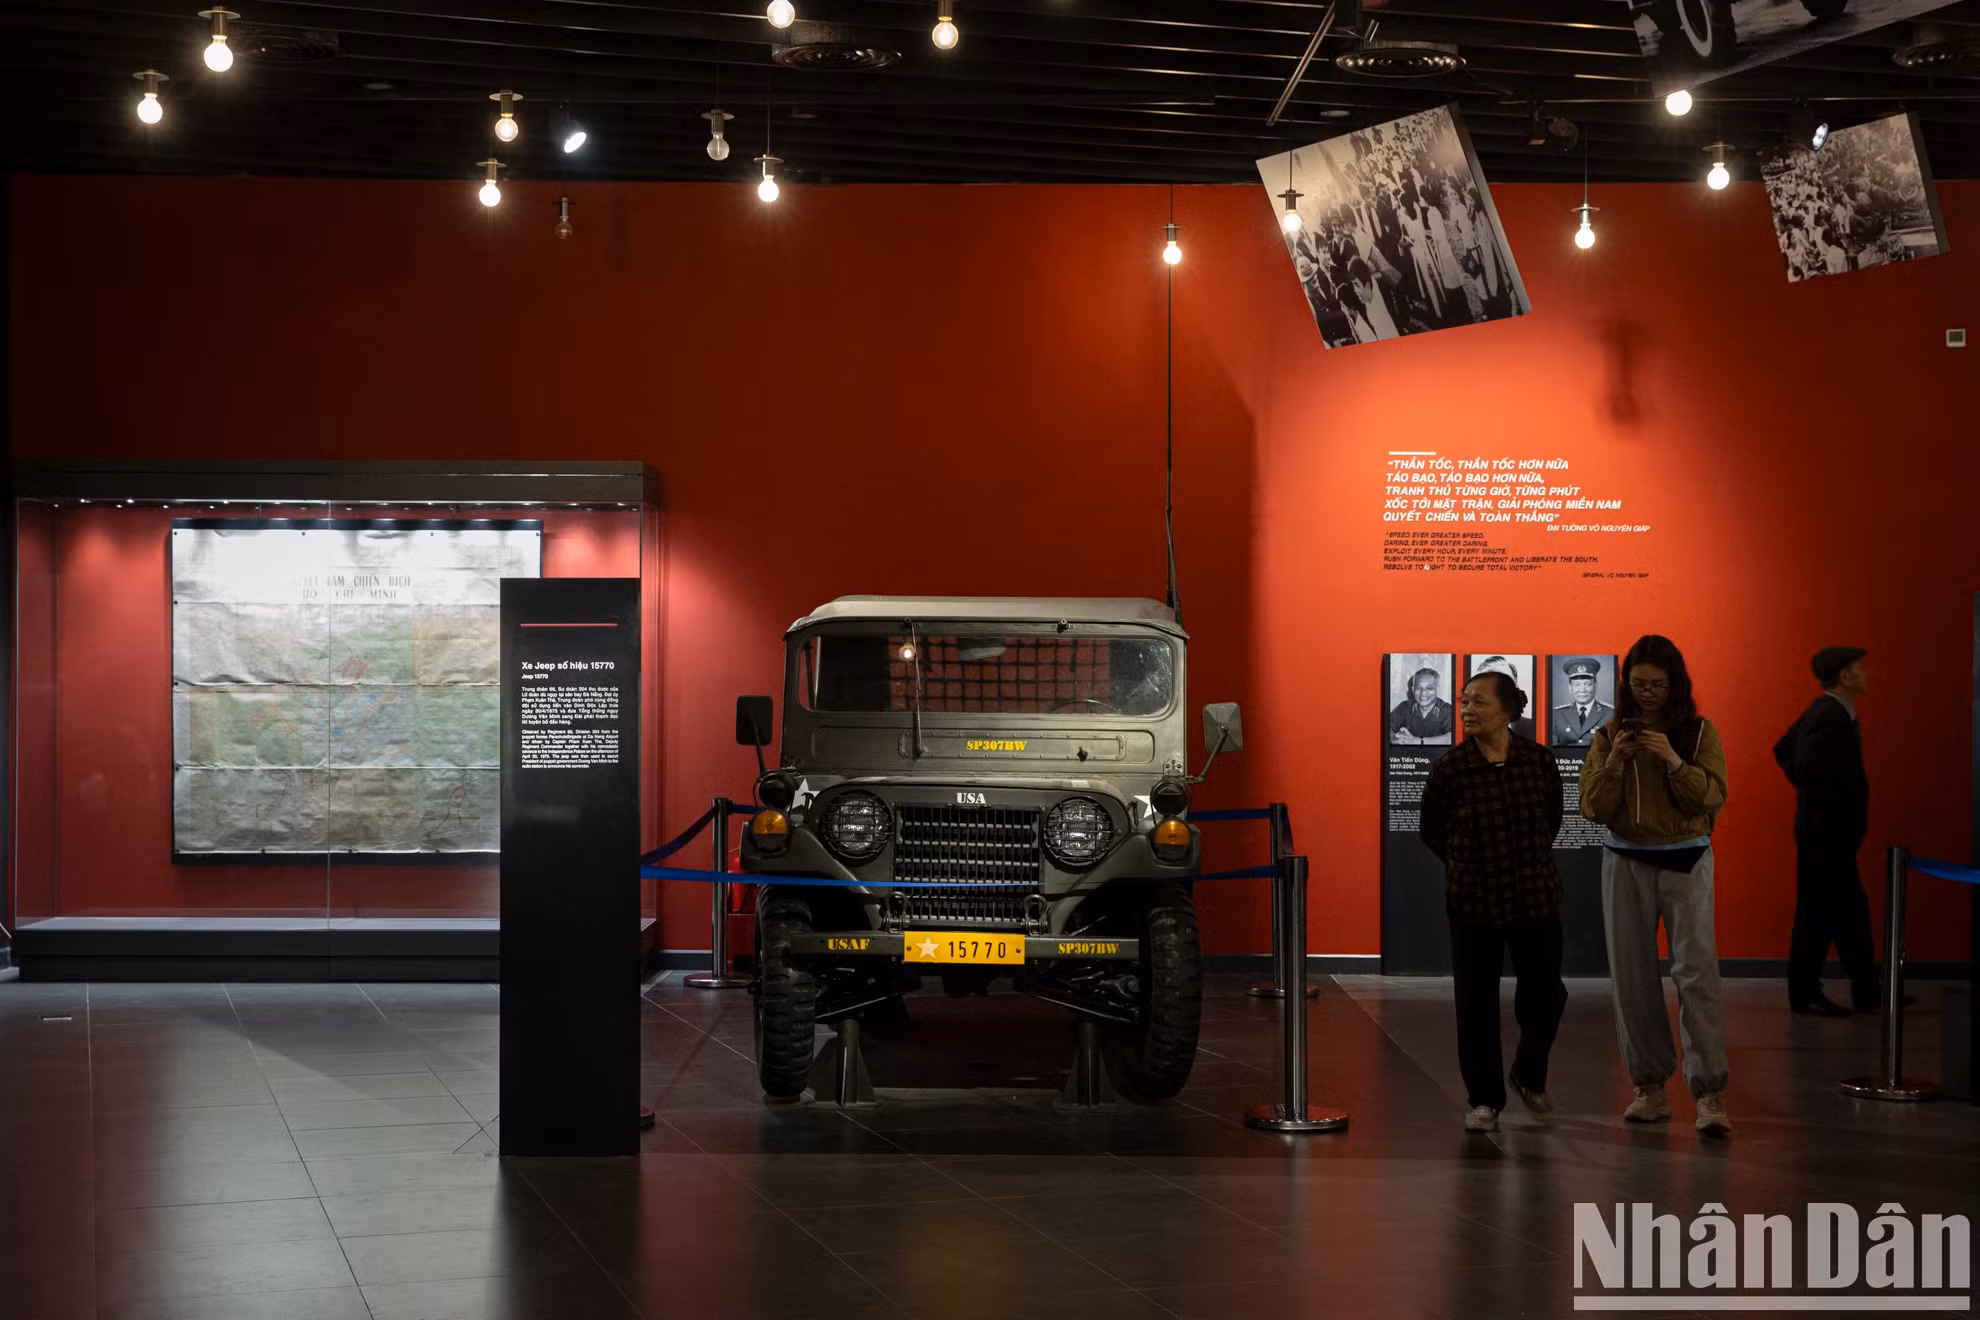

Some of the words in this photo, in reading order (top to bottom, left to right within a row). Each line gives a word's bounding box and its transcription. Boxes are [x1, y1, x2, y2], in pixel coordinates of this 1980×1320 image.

[1429, 457, 1454, 470] TỐC,
[1458, 456, 1488, 469] THẦN
[1492, 457, 1515, 469] TỐC
[1518, 459, 1544, 469] HƠN
[1546, 458, 1568, 469] NỮA
[1386, 471, 1408, 482] TÁO
[1412, 473, 1437, 484] BẠO,
[1440, 471, 1462, 482] TÁO
[1466, 473, 1489, 484] BẠO
[1492, 472, 1517, 483] HƠN
[1518, 472, 1544, 484] NỮA,
[1386, 486, 1424, 495] TRANH
[1429, 484, 1451, 495] THỦ
[1456, 484, 1486, 496] TỪNG
[1490, 484, 1512, 497] GIỜ,
[1515, 485, 1546, 496] TỪNG
[1549, 484, 1580, 496] PHÚT
[1385, 497, 1408, 509] XỐC
[1412, 497, 1431, 509] TỚI
[1433, 498, 1456, 510] MẶT
[1462, 498, 1493, 510] TRẬN,
[1498, 497, 1520, 509] GIẢI
[1523, 498, 1562, 509] PHÓNG
[1566, 496, 1593, 509] MIỀN
[1596, 500, 1622, 509] NAM
[1383, 510, 1422, 522] QUYẾT
[1425, 510, 1459, 522] CHIẾN
[1463, 510, 1476, 521] VÀ
[1480, 511, 1510, 522] TOÀN
[535, 662, 555, 671] Jeep
[557, 661, 568, 669] số
[570, 662, 588, 670] hiệu
[967, 740, 1027, 750] SP307BW
[957, 792, 986, 804] USA
[827, 937, 871, 950] USAF
[948, 941, 1006, 958] 15770
[1058, 943, 1120, 955] SP307BW
